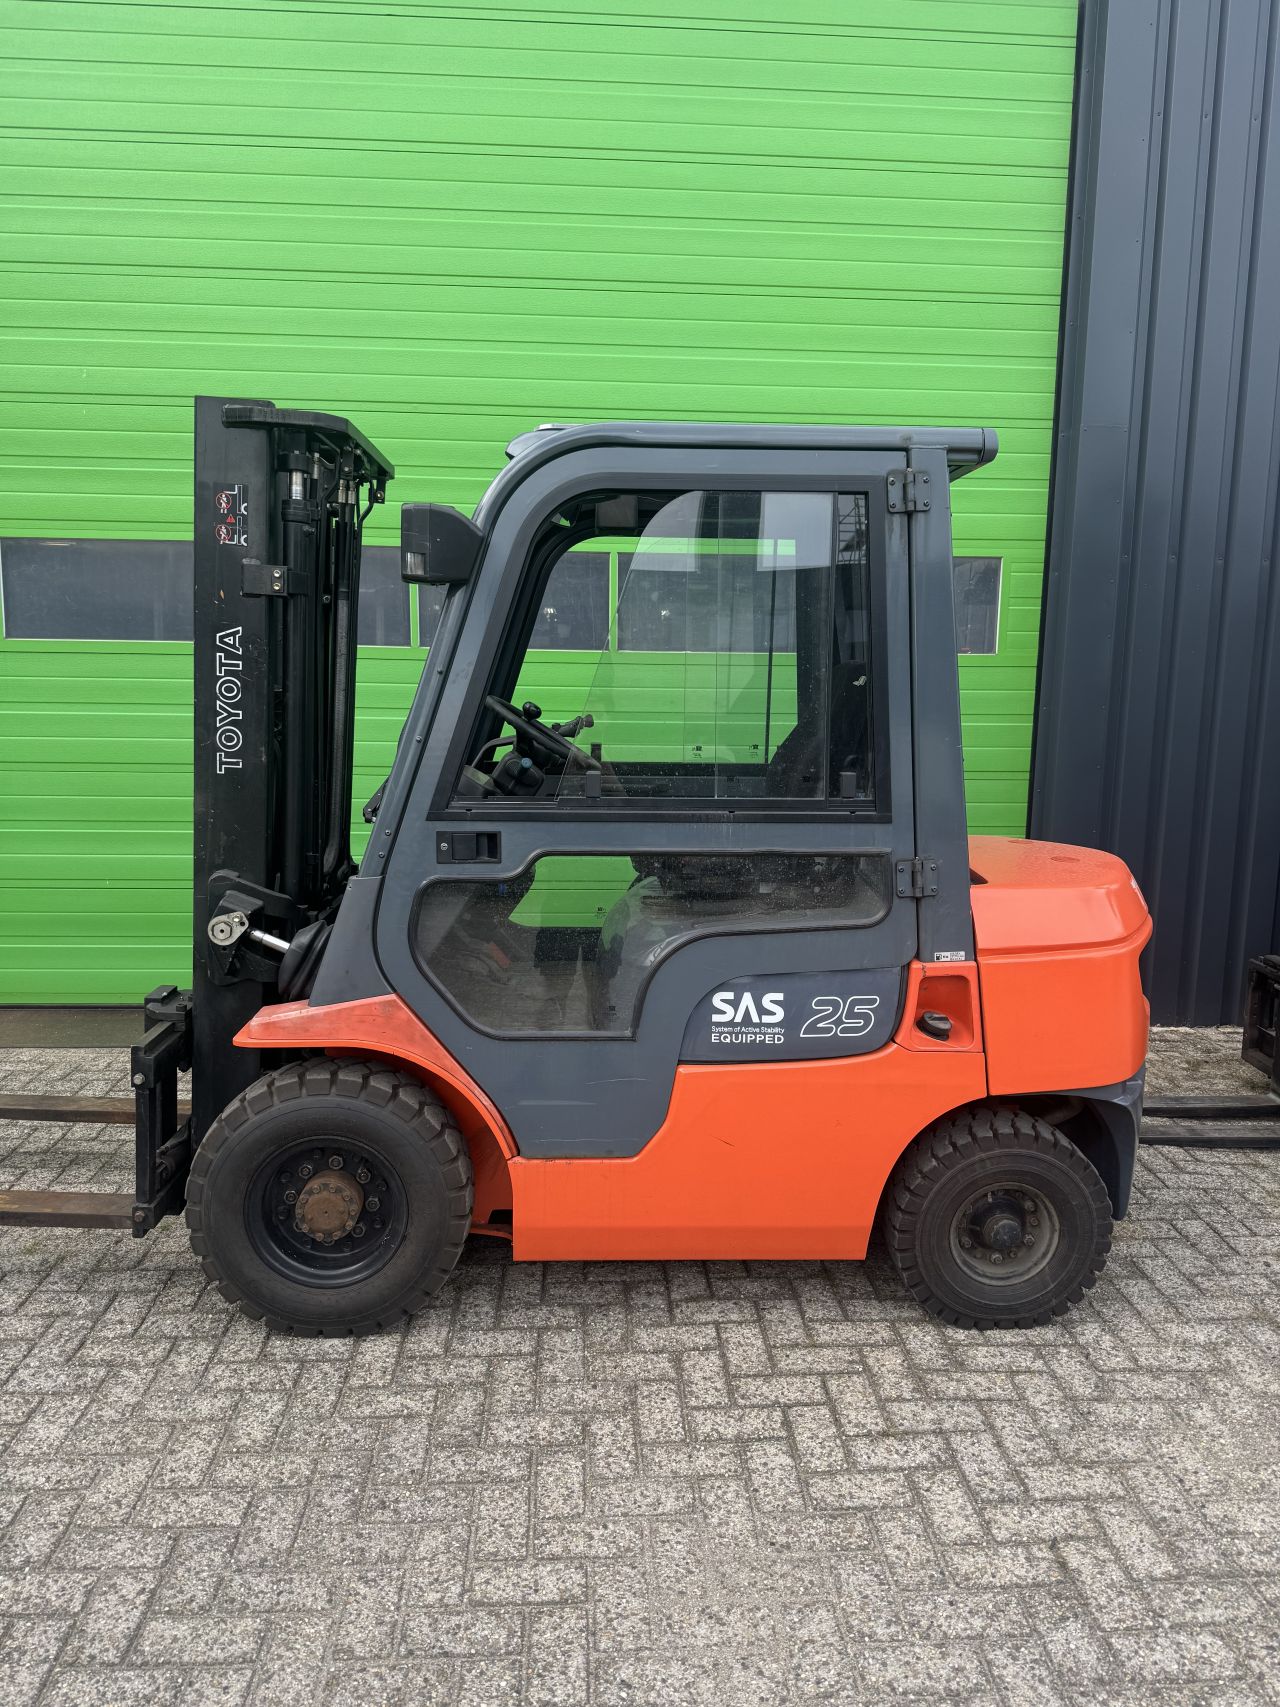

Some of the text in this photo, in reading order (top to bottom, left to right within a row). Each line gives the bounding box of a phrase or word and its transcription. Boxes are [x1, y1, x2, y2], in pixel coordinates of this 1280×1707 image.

[216, 626, 243, 774] TOYOTA
[711, 991, 785, 1024] SAS
[800, 995, 880, 1038] 25
[711, 1025, 733, 1034] System
[760, 1026, 785, 1034] Stability
[711, 1033, 785, 1044] EQUIPPED
